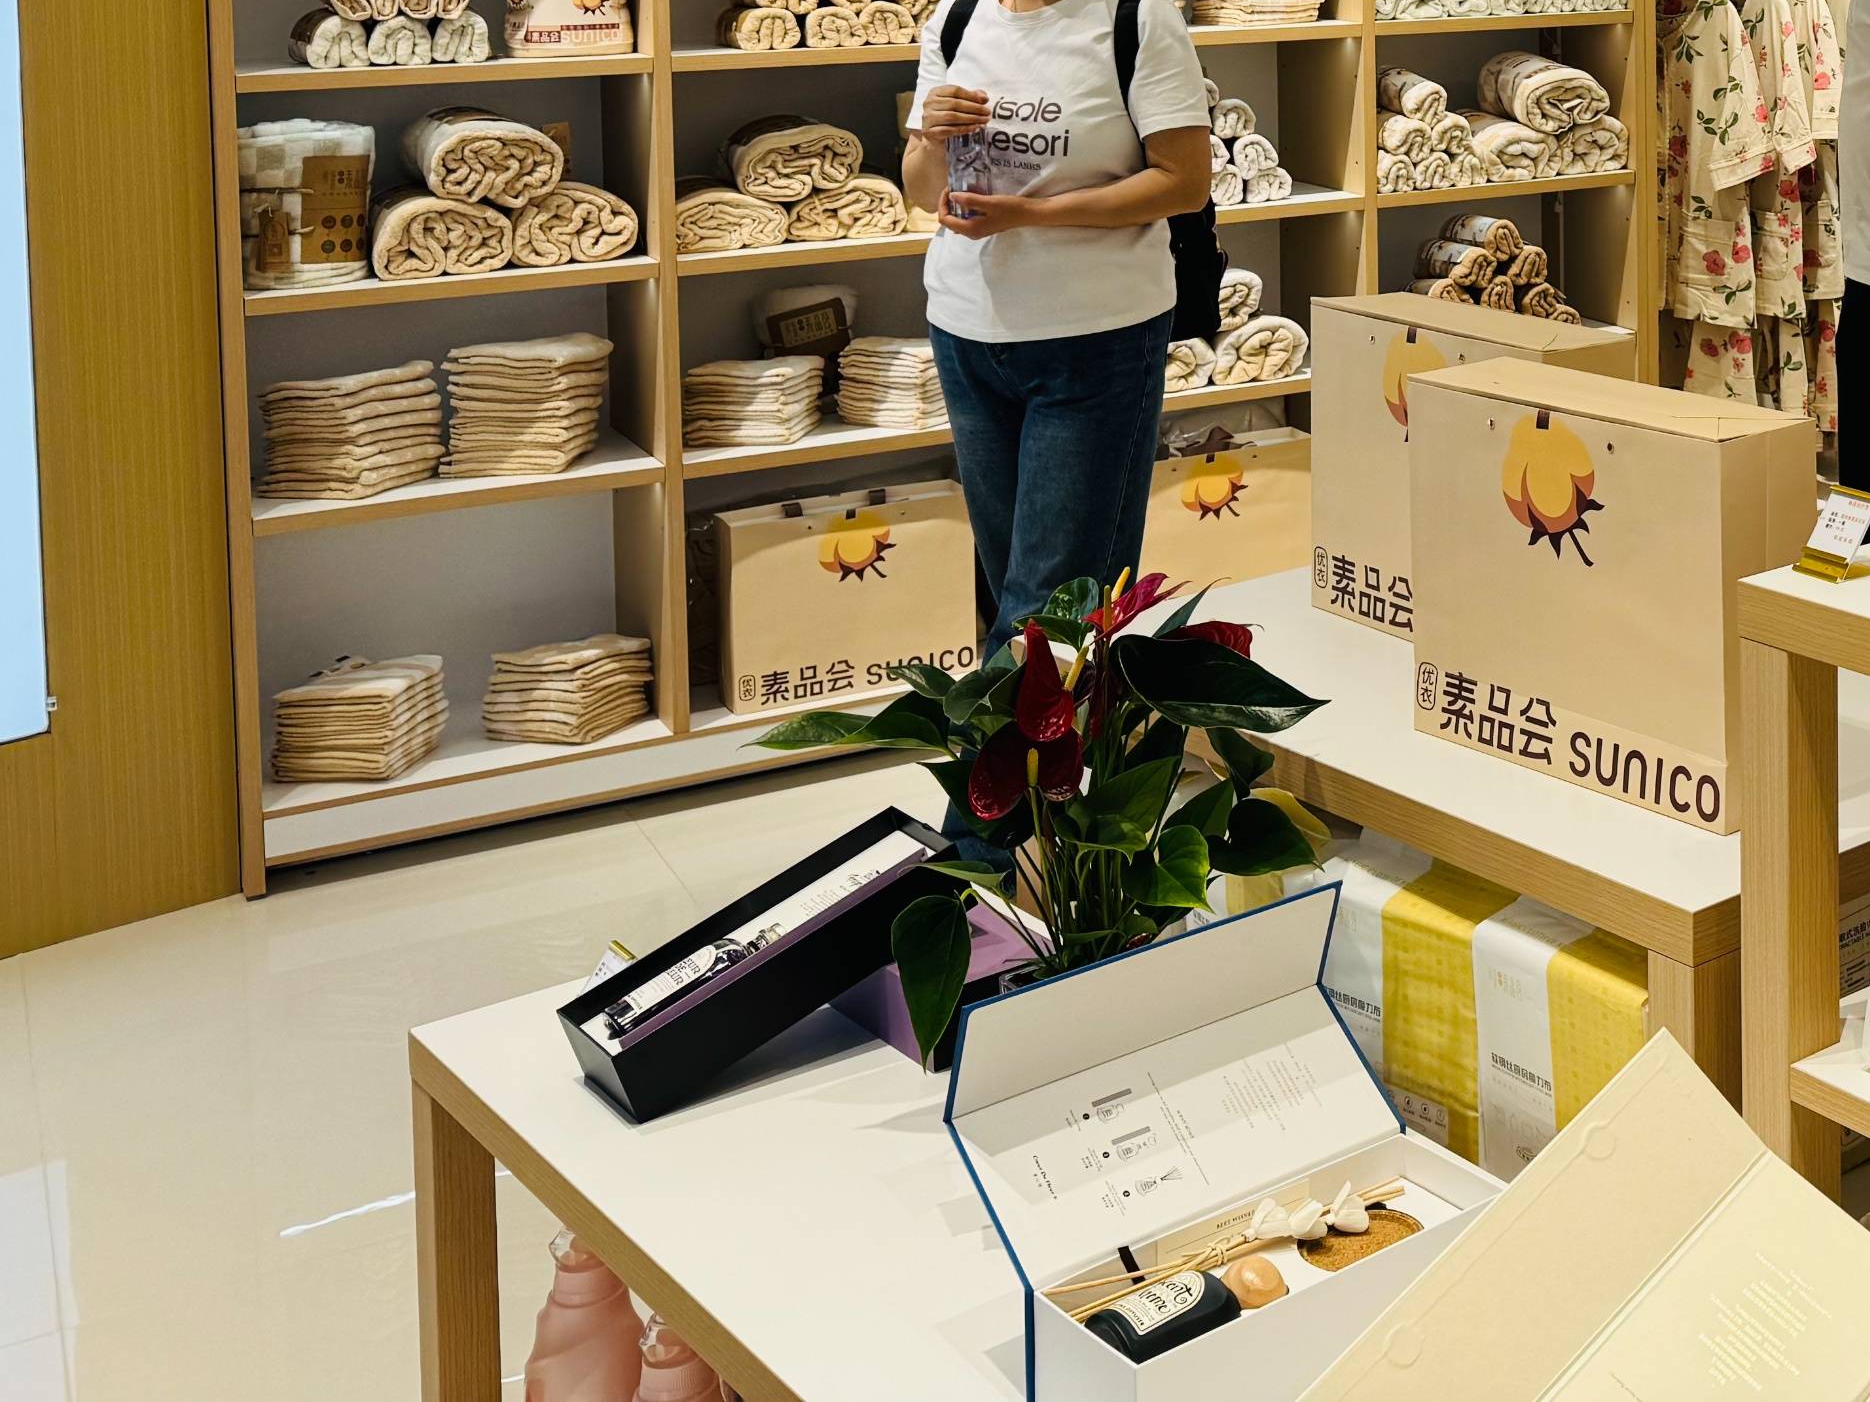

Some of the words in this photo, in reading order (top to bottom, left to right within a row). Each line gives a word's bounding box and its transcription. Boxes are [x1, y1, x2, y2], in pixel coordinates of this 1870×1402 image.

[760, 658, 856, 706] 素品会
[1439, 671, 1557, 766] 素品会
